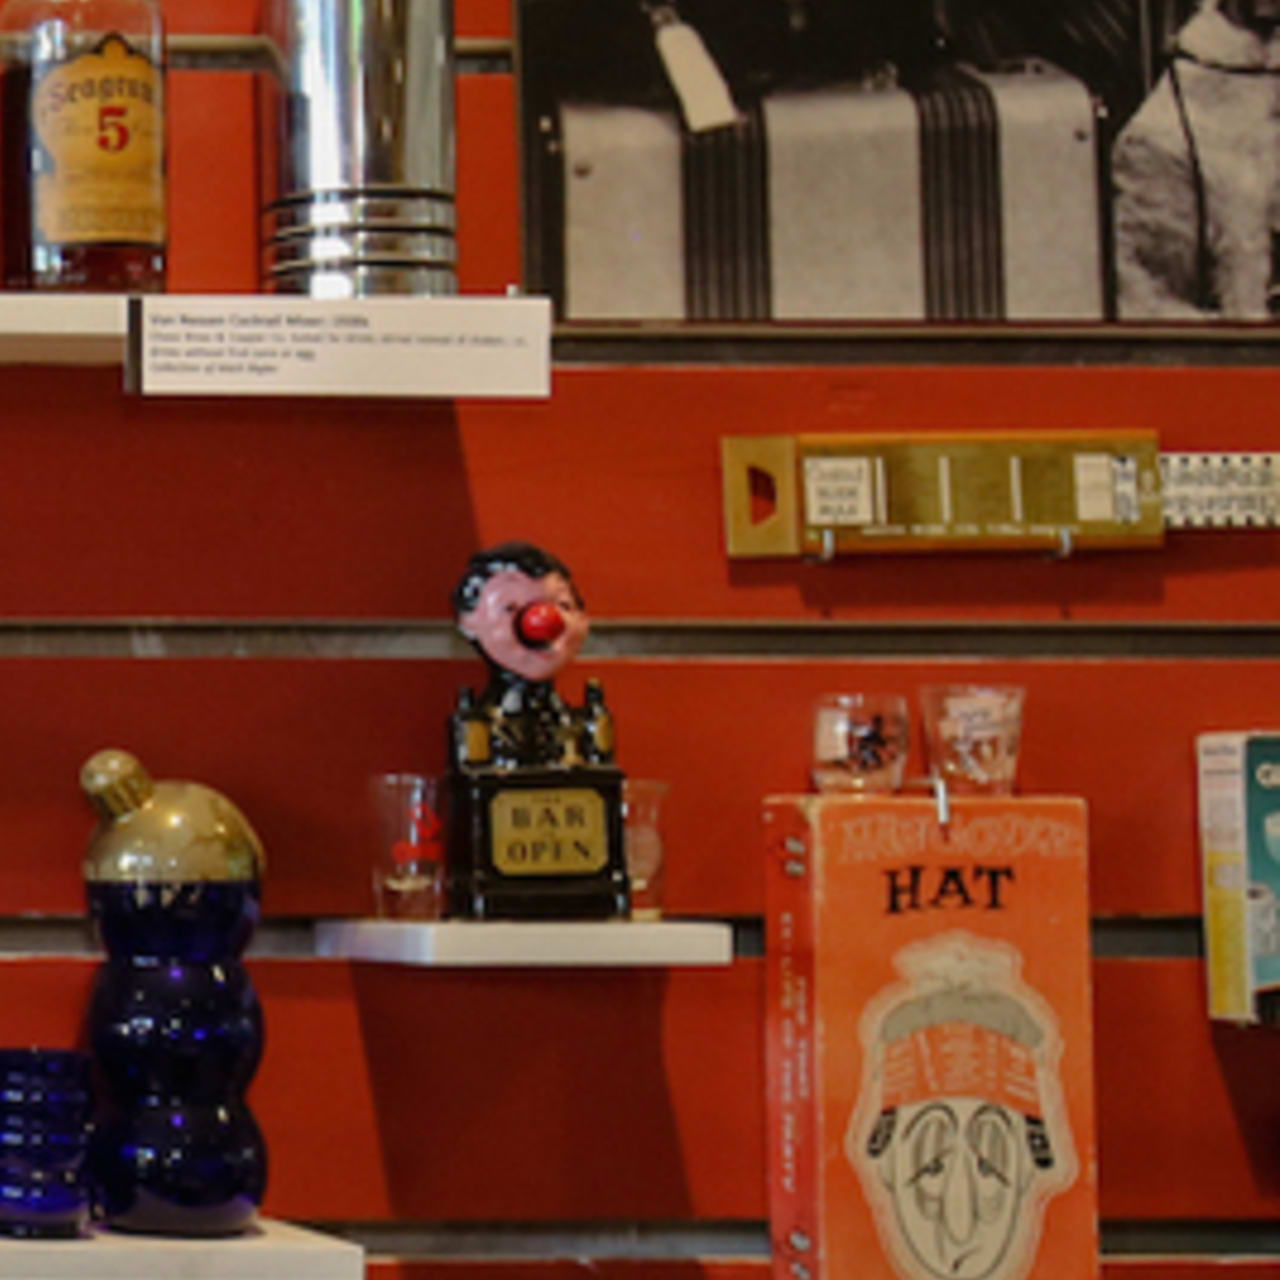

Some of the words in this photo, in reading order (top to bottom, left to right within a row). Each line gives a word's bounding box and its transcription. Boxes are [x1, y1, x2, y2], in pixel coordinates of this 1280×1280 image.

[96, 104, 131, 153] 5
[510, 804, 587, 830] BAR
[506, 839, 592, 864] OPEN
[881, 864, 1017, 915] HAT
